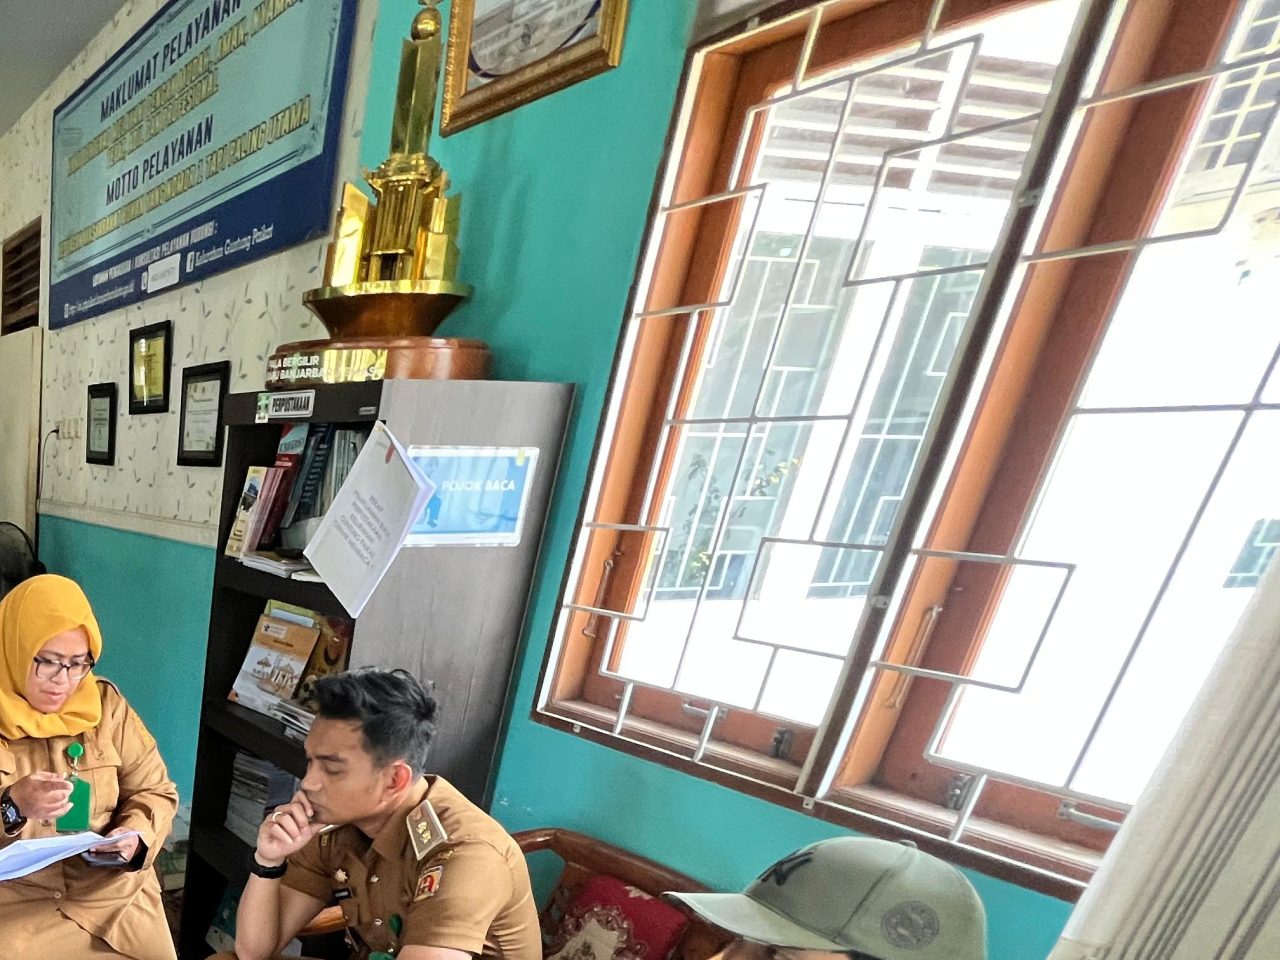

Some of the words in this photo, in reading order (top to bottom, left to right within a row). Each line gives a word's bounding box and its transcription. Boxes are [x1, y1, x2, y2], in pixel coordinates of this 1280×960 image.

[101, 52, 159, 123] MAKLUMAT
[205, 143, 227, 179] TAPI
[227, 121, 267, 167] PALING
[267, 94, 310, 144] UTAMA
[106, 164, 139, 206] MOTTO
[142, 113, 213, 184] PELAYANAN
[225, 235, 252, 255] Guntung
[252, 222, 274, 245] Paikat
[281, 368, 331, 380] BANJARBA
[283, 355, 320, 367] BERGILIR
[441, 480, 479, 491] POJOK
[485, 479, 515, 491] BACA
